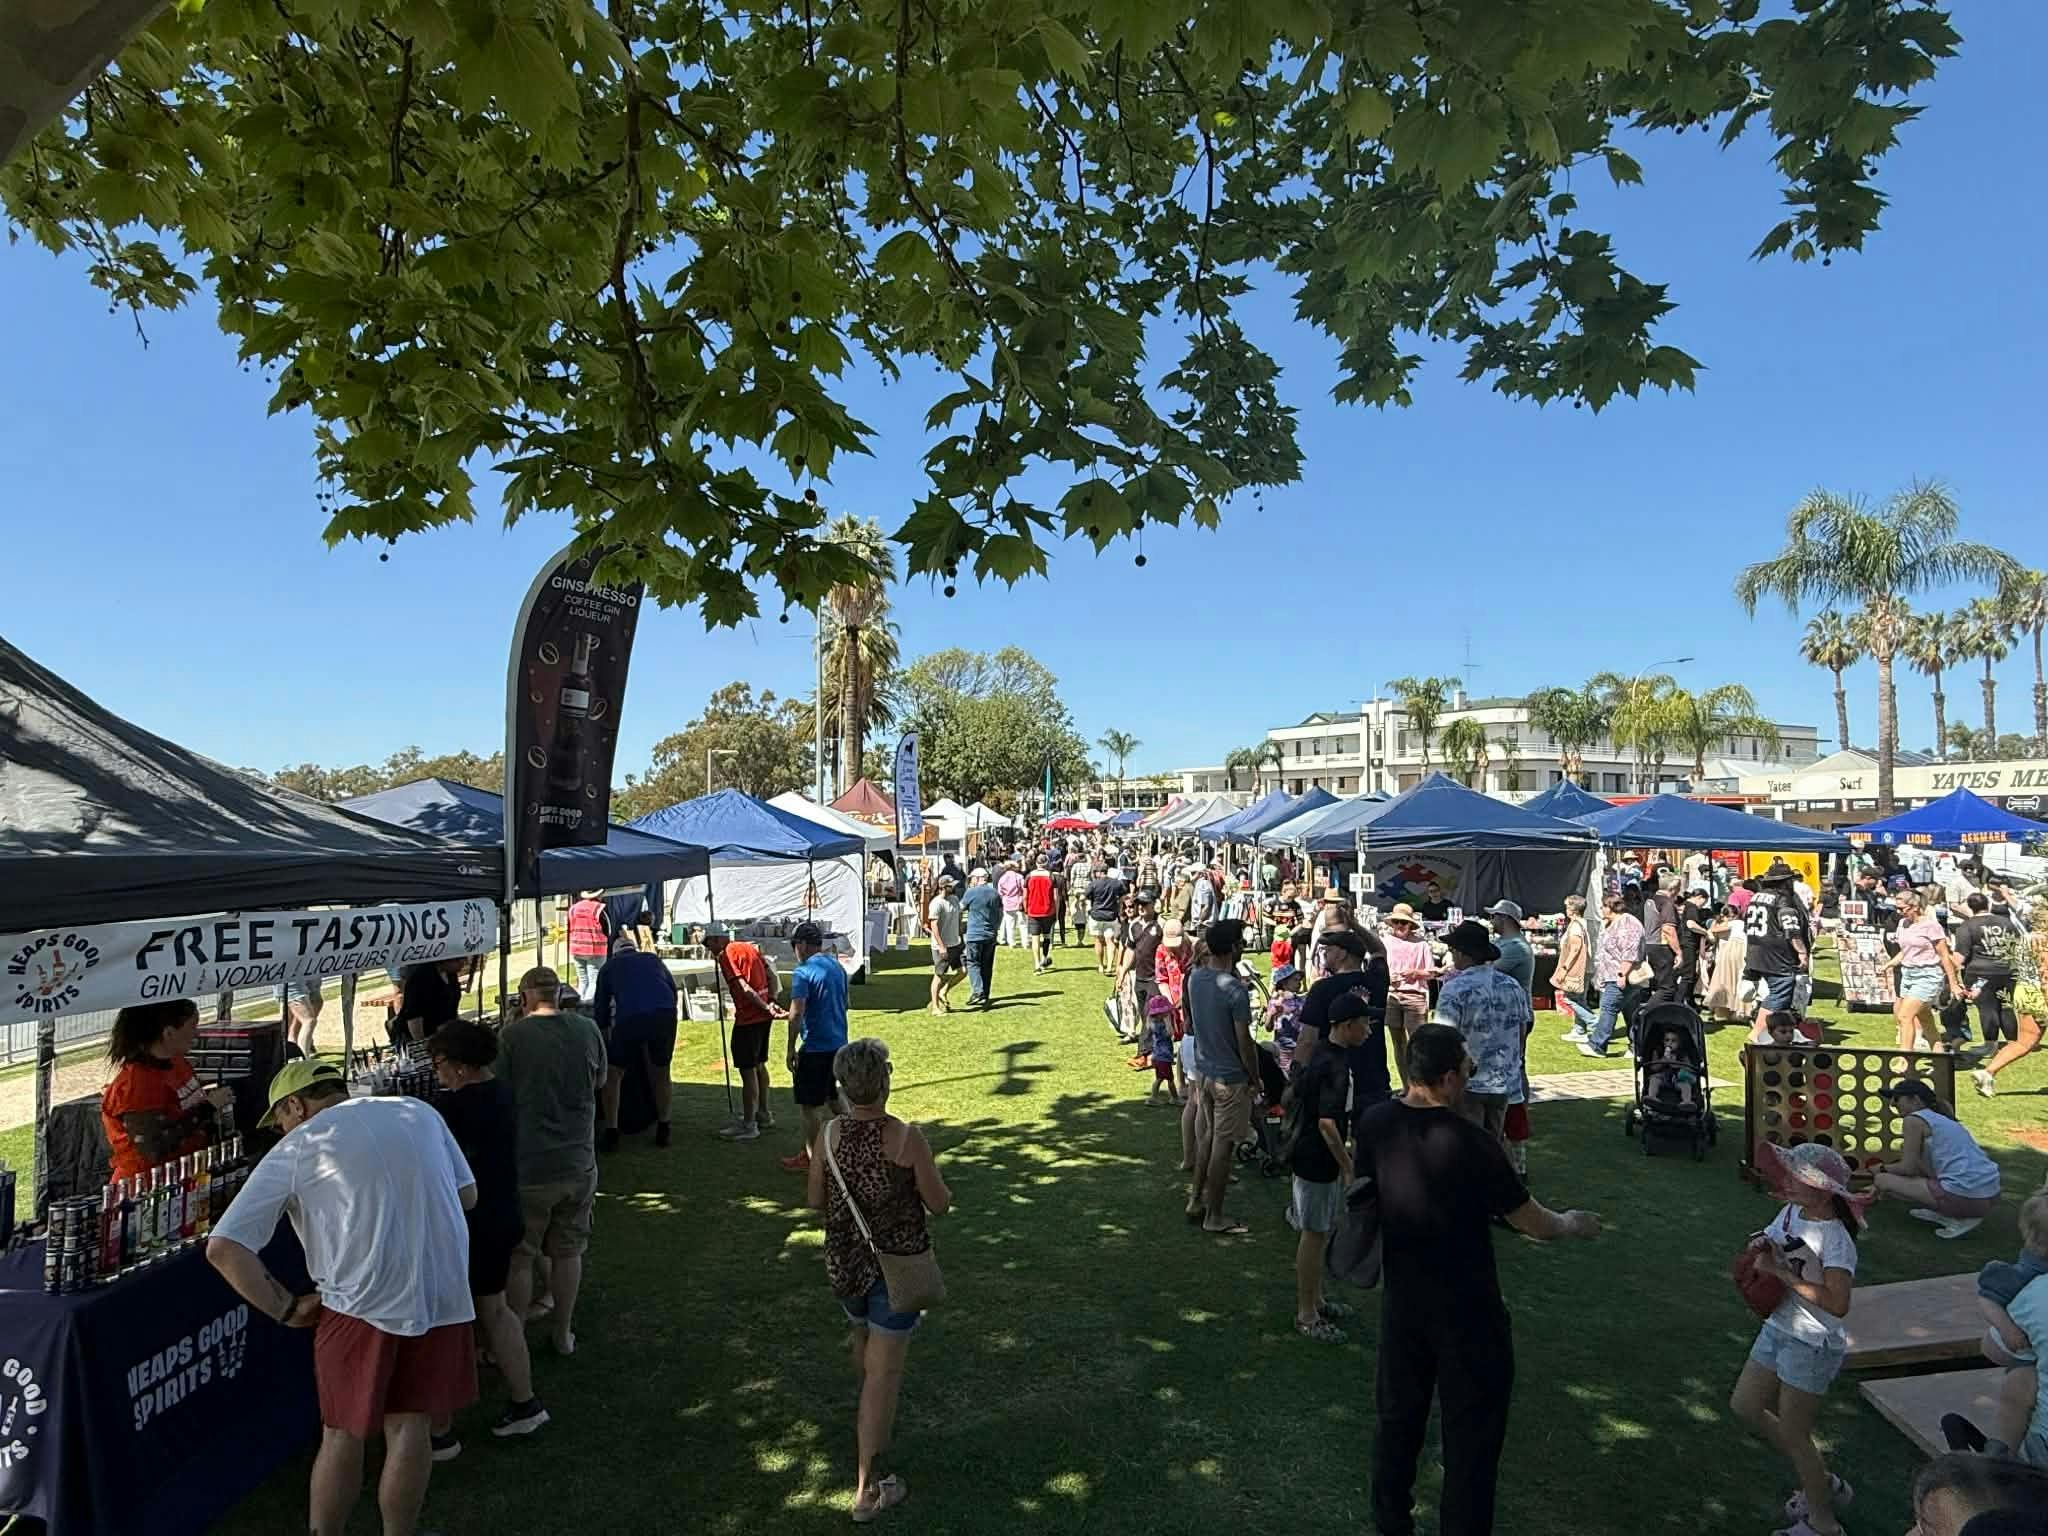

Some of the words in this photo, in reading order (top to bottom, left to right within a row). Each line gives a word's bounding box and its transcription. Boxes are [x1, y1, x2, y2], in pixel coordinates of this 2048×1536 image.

[563, 594, 602, 611] COFFEE
[603, 604, 620, 616] GIN
[569, 606, 611, 624] LIQUEUR
[1767, 780, 1792, 792] Yates
[1839, 777, 1863, 790] Surf
[1931, 770, 2001, 790] YATES
[1906, 834, 1933, 845] LIONS
[1746, 905, 1768, 937] 23
[8, 933, 61, 975] HEAPS
[63, 933, 100, 969] GOOD
[135, 920, 275, 971] FREE
[292, 907, 450, 956] TASTINGS
[140, 972, 186, 999] GIN
[215, 962, 287, 989] VODKA
[303, 949, 390, 977] LIQUEURS
[401, 942, 446, 962] CELLO
[16, 984, 80, 1013] SPIRITS
[127, 1335, 193, 1398] HEAPS
[198, 1303, 249, 1354] GOOD
[2, 1358, 47, 1416] GOOD
[134, 1355, 212, 1432] SPIRITS
